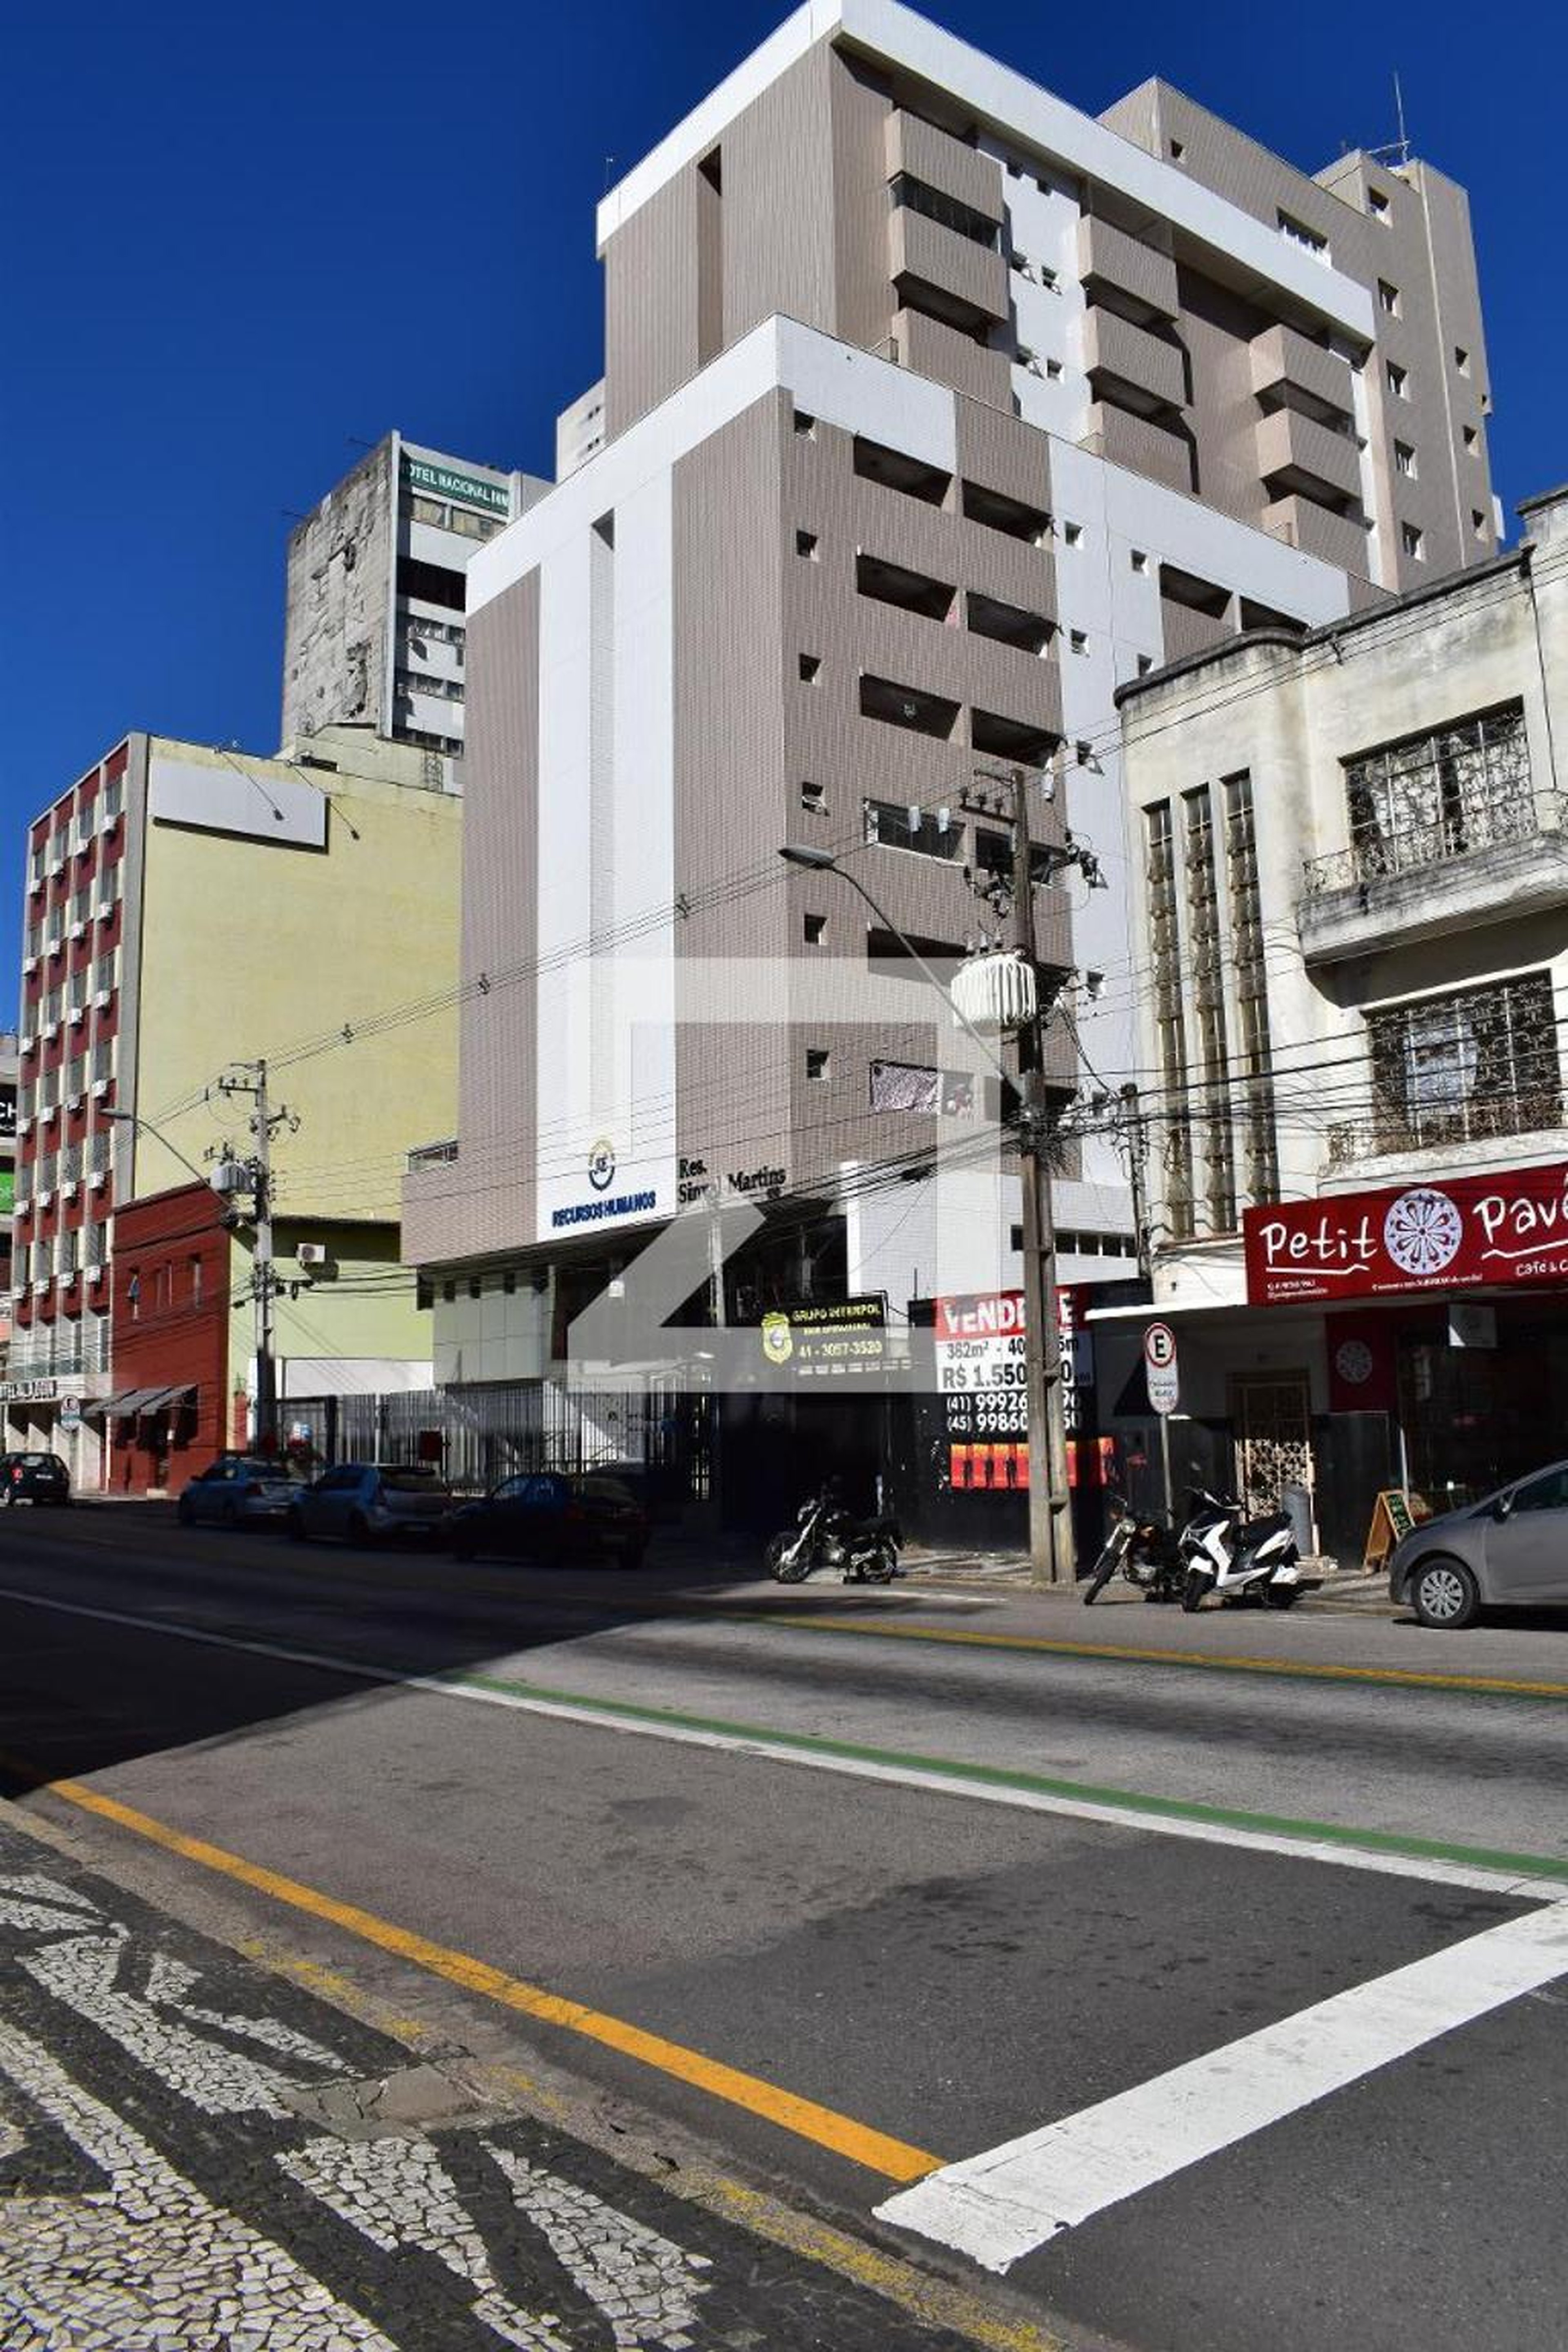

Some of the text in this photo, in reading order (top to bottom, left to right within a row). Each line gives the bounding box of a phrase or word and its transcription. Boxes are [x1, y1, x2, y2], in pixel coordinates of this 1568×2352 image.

[439, 474, 490, 501] NACIONAL
[679, 1158, 707, 1178] Res.
[727, 1165, 786, 1192] Martins
[552, 1189, 656, 1227] RECURSOS HUMANOS
[1259, 1215, 1379, 1265] Petit
[792, 1308, 828, 1322] GRUPO
[1154, 1335, 1165, 1358] E
[942, 1363, 967, 1388] R$
[947, 1396, 971, 1412] (41)
[947, 1416, 972, 1432] (45)
